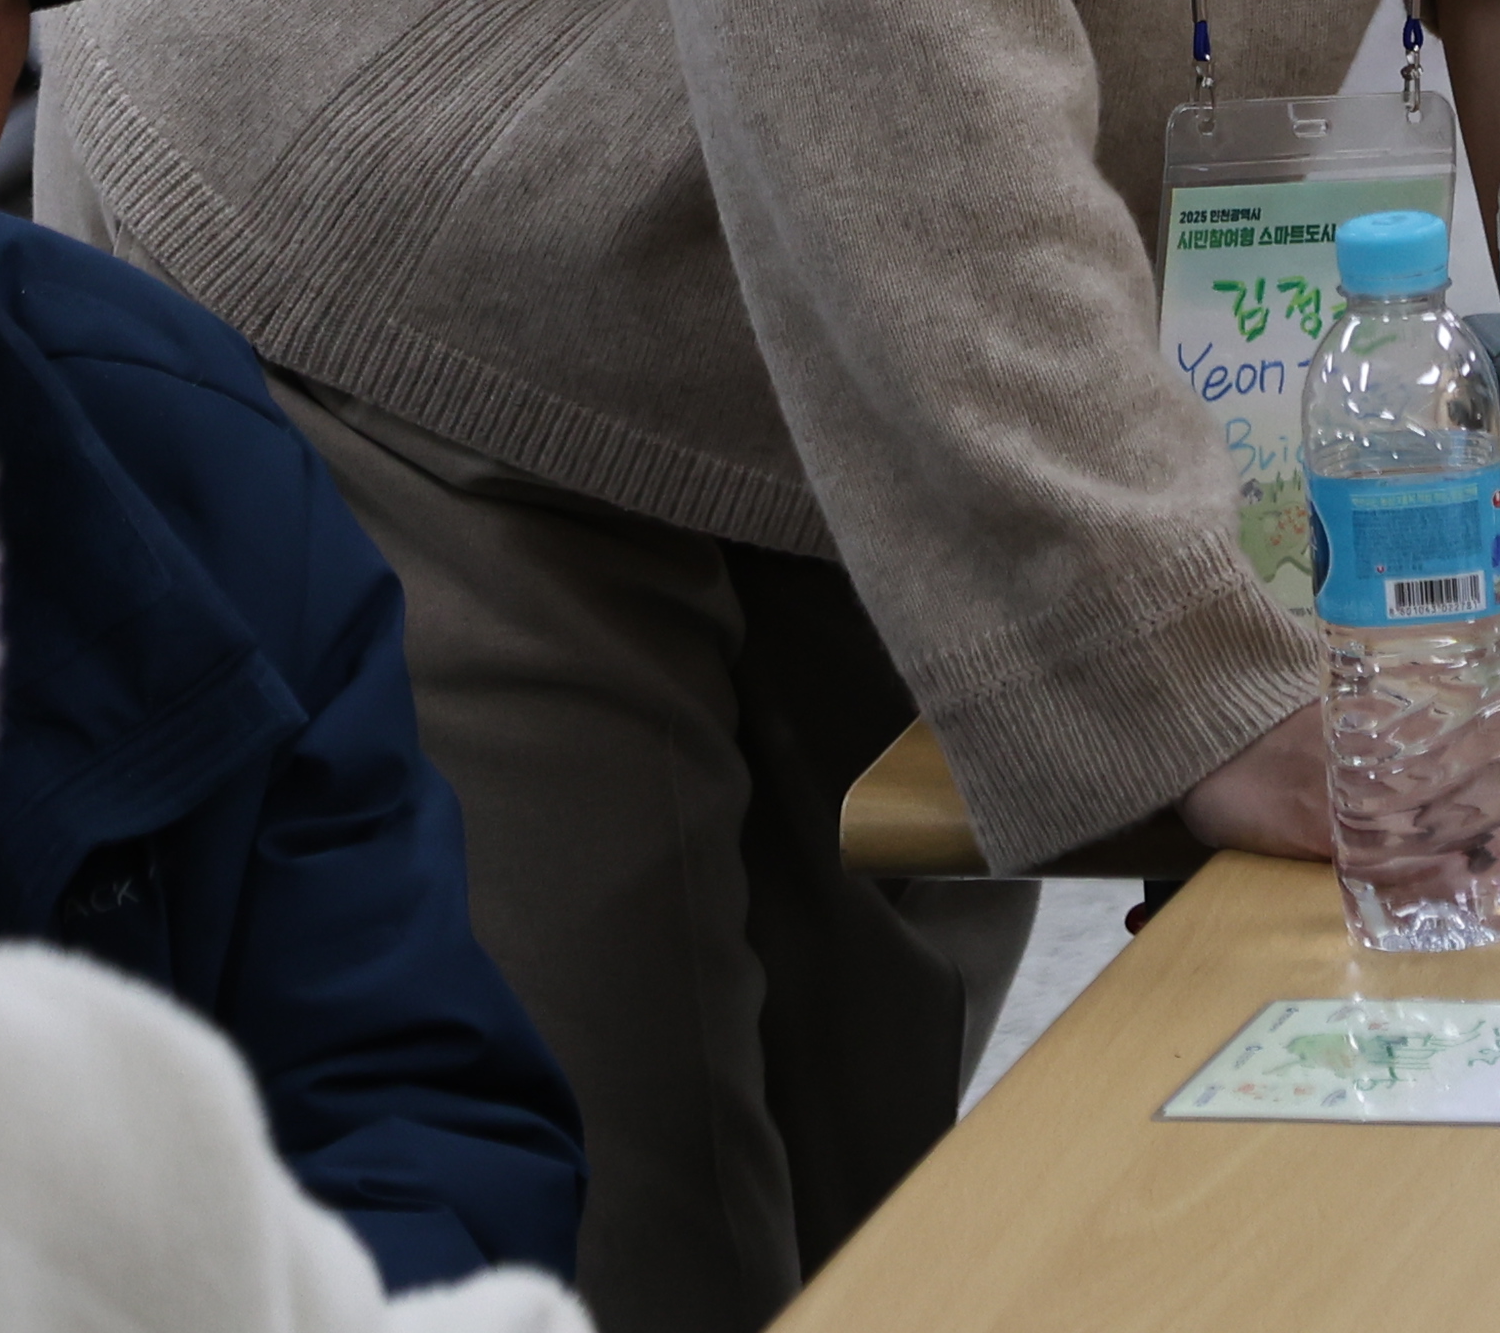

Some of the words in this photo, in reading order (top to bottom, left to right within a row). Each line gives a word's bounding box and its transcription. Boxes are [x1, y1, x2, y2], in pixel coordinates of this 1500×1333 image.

[1179, 210, 1207, 224] 2025
[1210, 207, 1262, 223] 인천광역시
[1177, 227, 1255, 250] 시민참여형
[1258, 223, 1337, 246] 스마트도시
